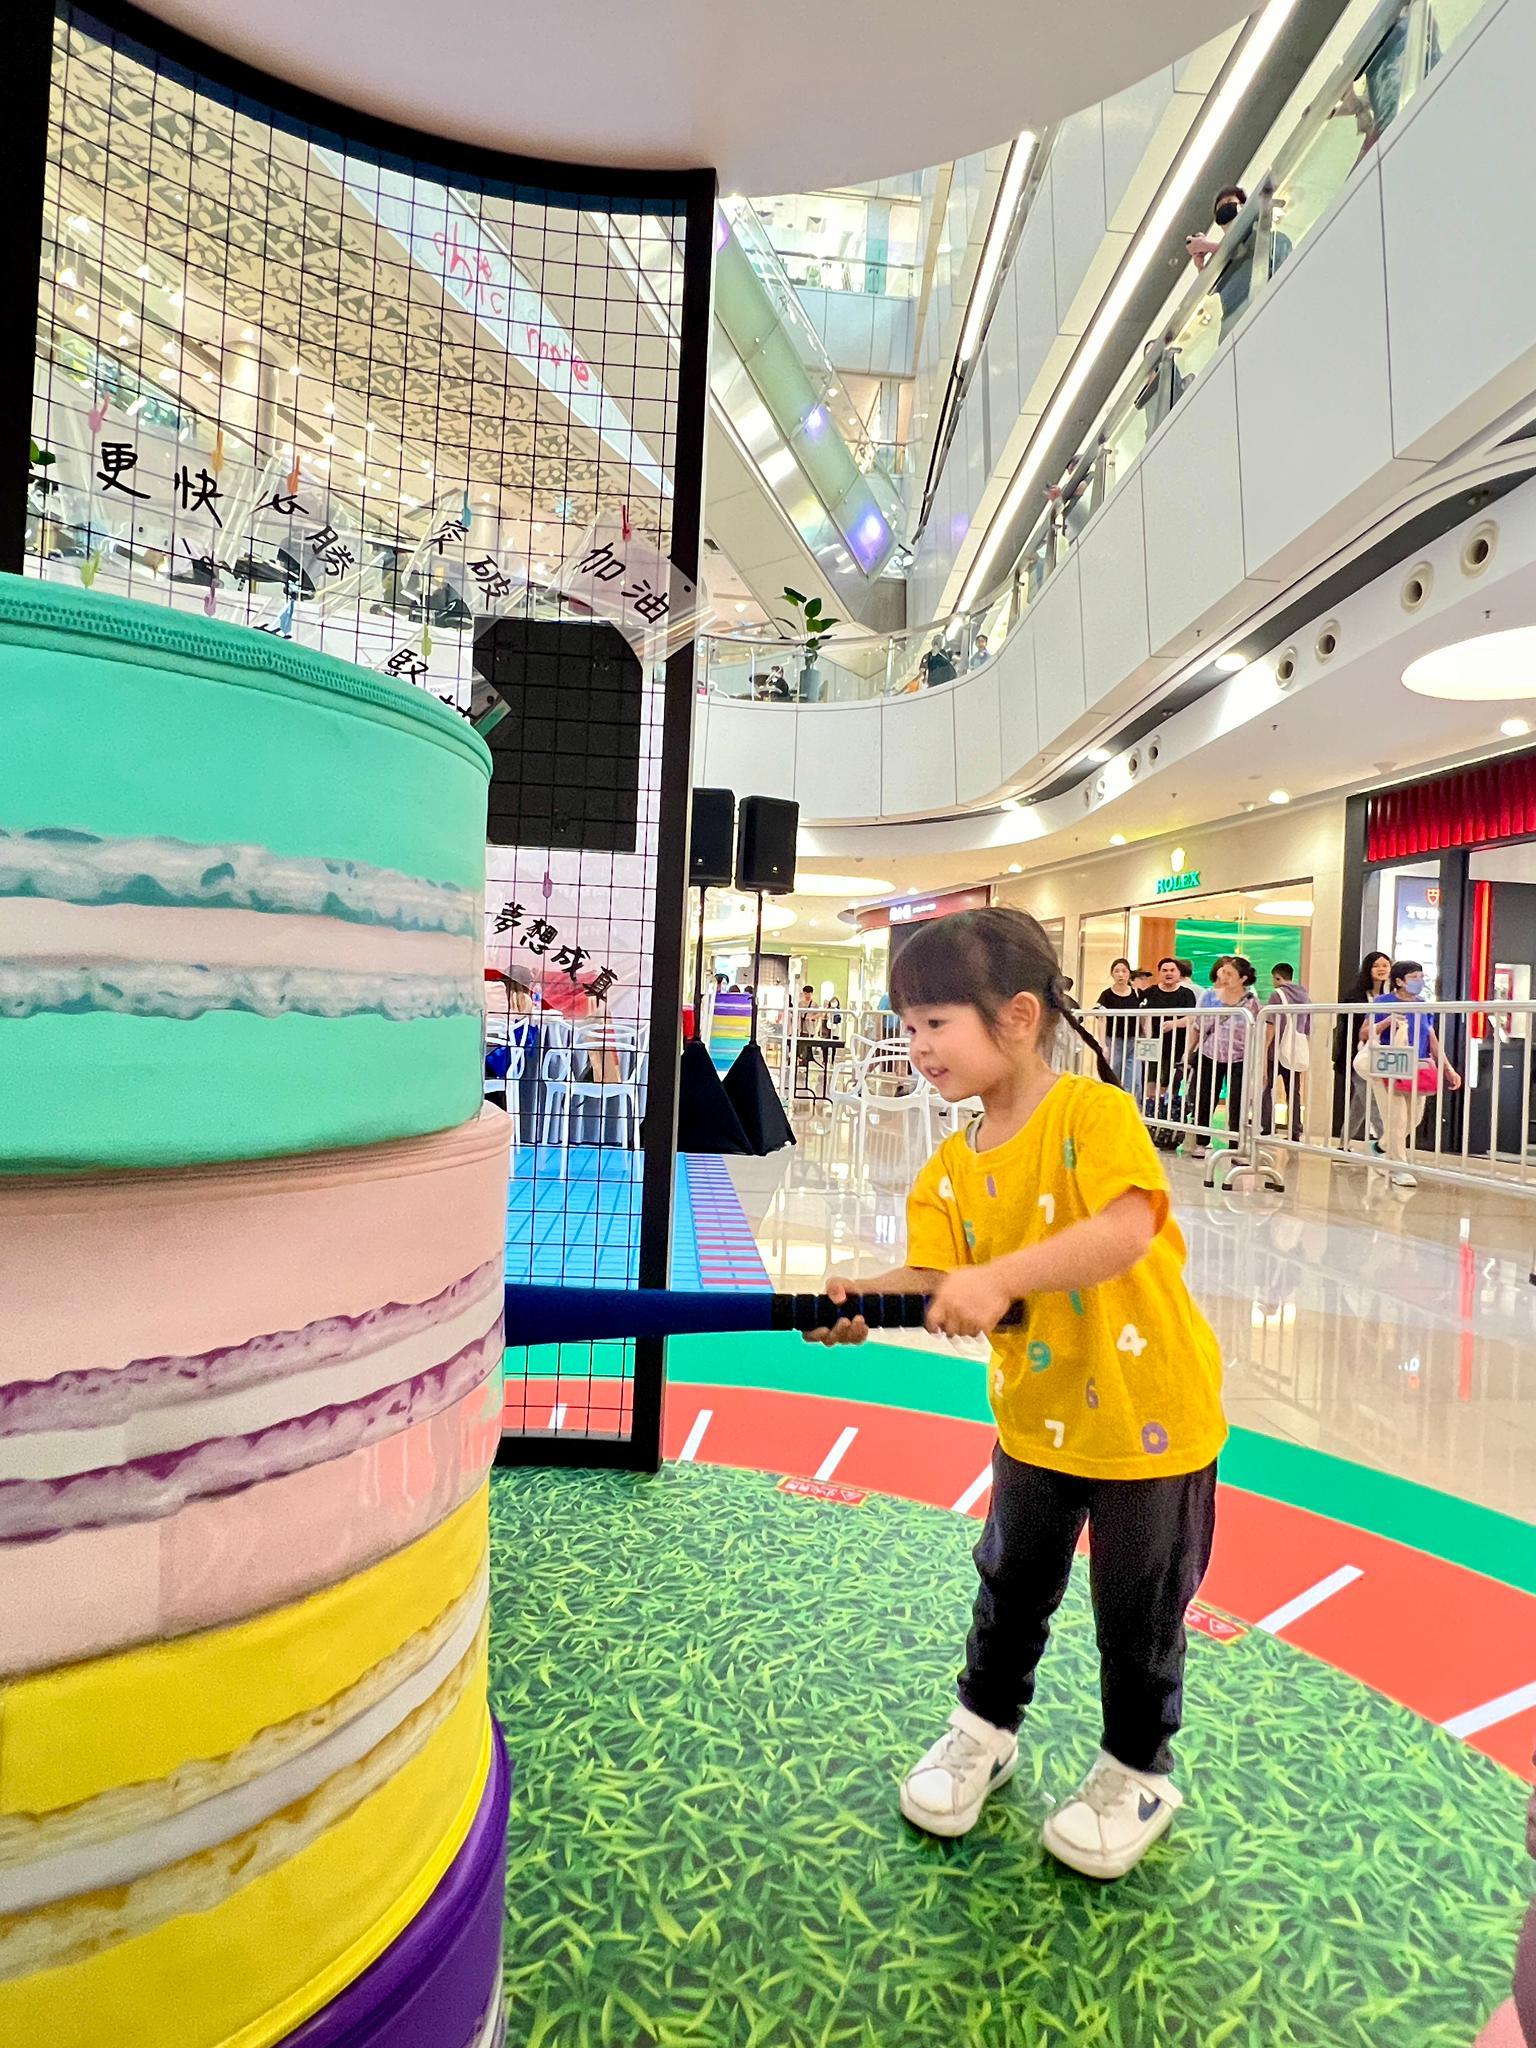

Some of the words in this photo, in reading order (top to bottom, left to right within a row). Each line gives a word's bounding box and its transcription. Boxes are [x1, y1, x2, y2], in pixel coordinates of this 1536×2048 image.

[96, 441, 223, 528] 更快
[577, 542, 670, 624] 加油
[1155, 870, 1201, 894] ROLEX
[493, 901, 619, 1008] 夢想成真
[1028, 1340, 1052, 1373] 9
[1116, 1323, 1147, 1357] 4
[1044, 1418, 1065, 1449] 7
[1141, 1421, 1169, 1455] 0
